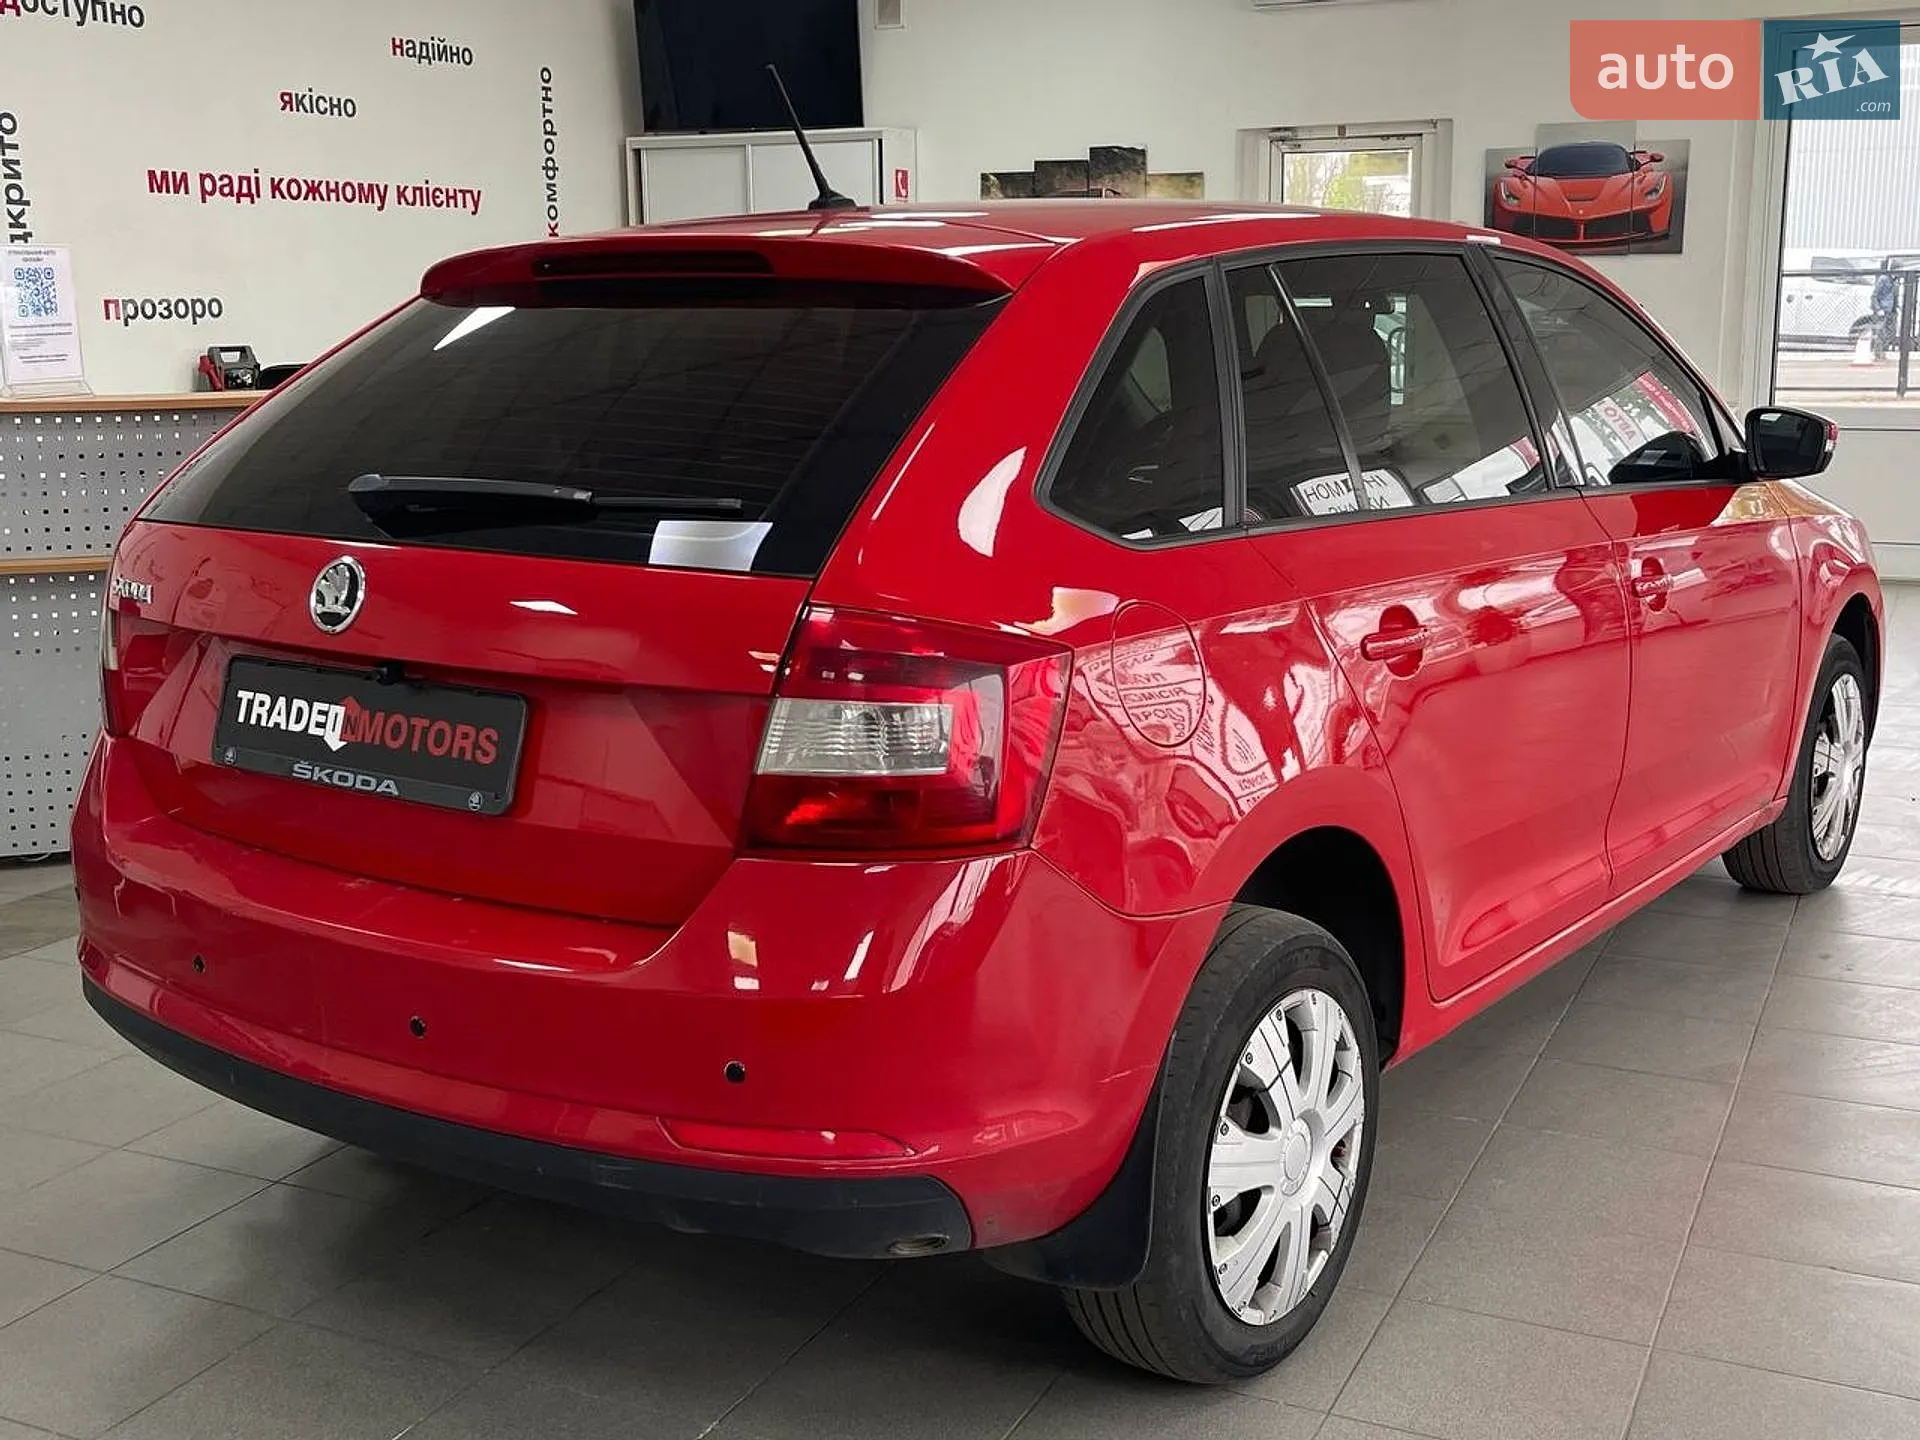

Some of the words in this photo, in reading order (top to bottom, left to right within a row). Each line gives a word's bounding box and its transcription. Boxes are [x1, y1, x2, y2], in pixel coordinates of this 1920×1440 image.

[391, 36, 473, 66] надійно
[279, 87, 357, 118] якісно
[540, 67, 560, 238] комфортно
[147, 169, 190, 195] ми
[199, 168, 261, 205] раді
[270, 176, 388, 212] кожному
[396, 179, 481, 216] клієнту
[103, 298, 223, 326] прозоро
[361, 709, 499, 765] MOTORS
[292, 760, 399, 796] ŠKODA
